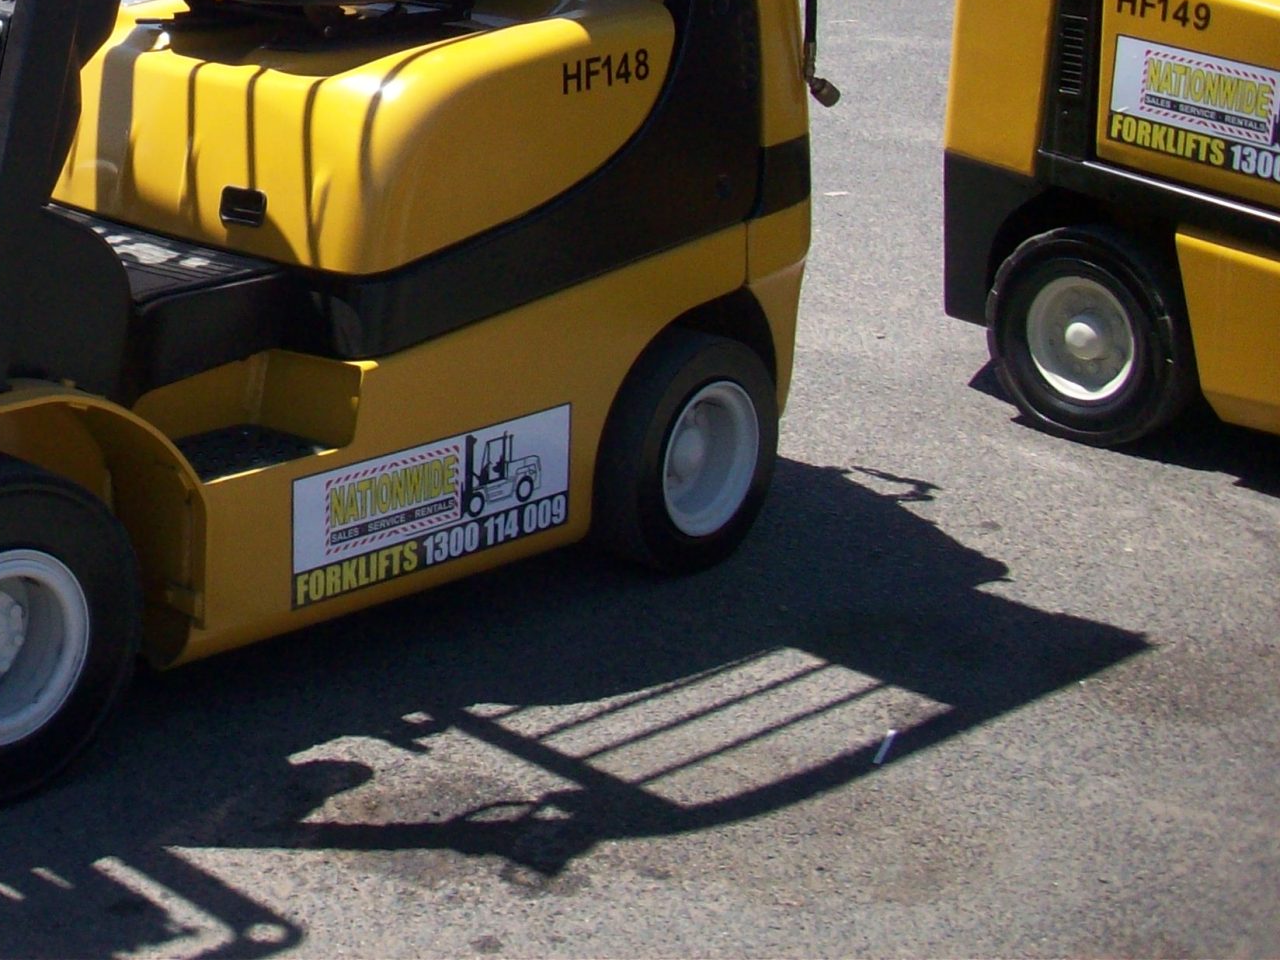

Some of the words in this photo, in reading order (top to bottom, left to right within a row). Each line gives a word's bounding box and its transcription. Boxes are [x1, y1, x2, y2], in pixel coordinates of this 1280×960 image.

[562, 48, 650, 95] HF148
[1146, 57, 1271, 120] NATIONWIDE
[1145, 94, 1171, 109] SALES
[1178, 103, 1217, 120] SERVICE
[1224, 114, 1267, 132] RENTALS
[1111, 114, 1226, 166] FORKLIFTS
[330, 454, 457, 528] NATIONWIDE
[331, 526, 359, 544] SALES
[367, 514, 406, 533] SERVICE
[414, 499, 455, 520] RENTALS
[295, 541, 419, 606] FORKLIFTS
[423, 522, 482, 566] 1300
[484, 509, 518, 546] 114
[523, 494, 566, 534] 009
